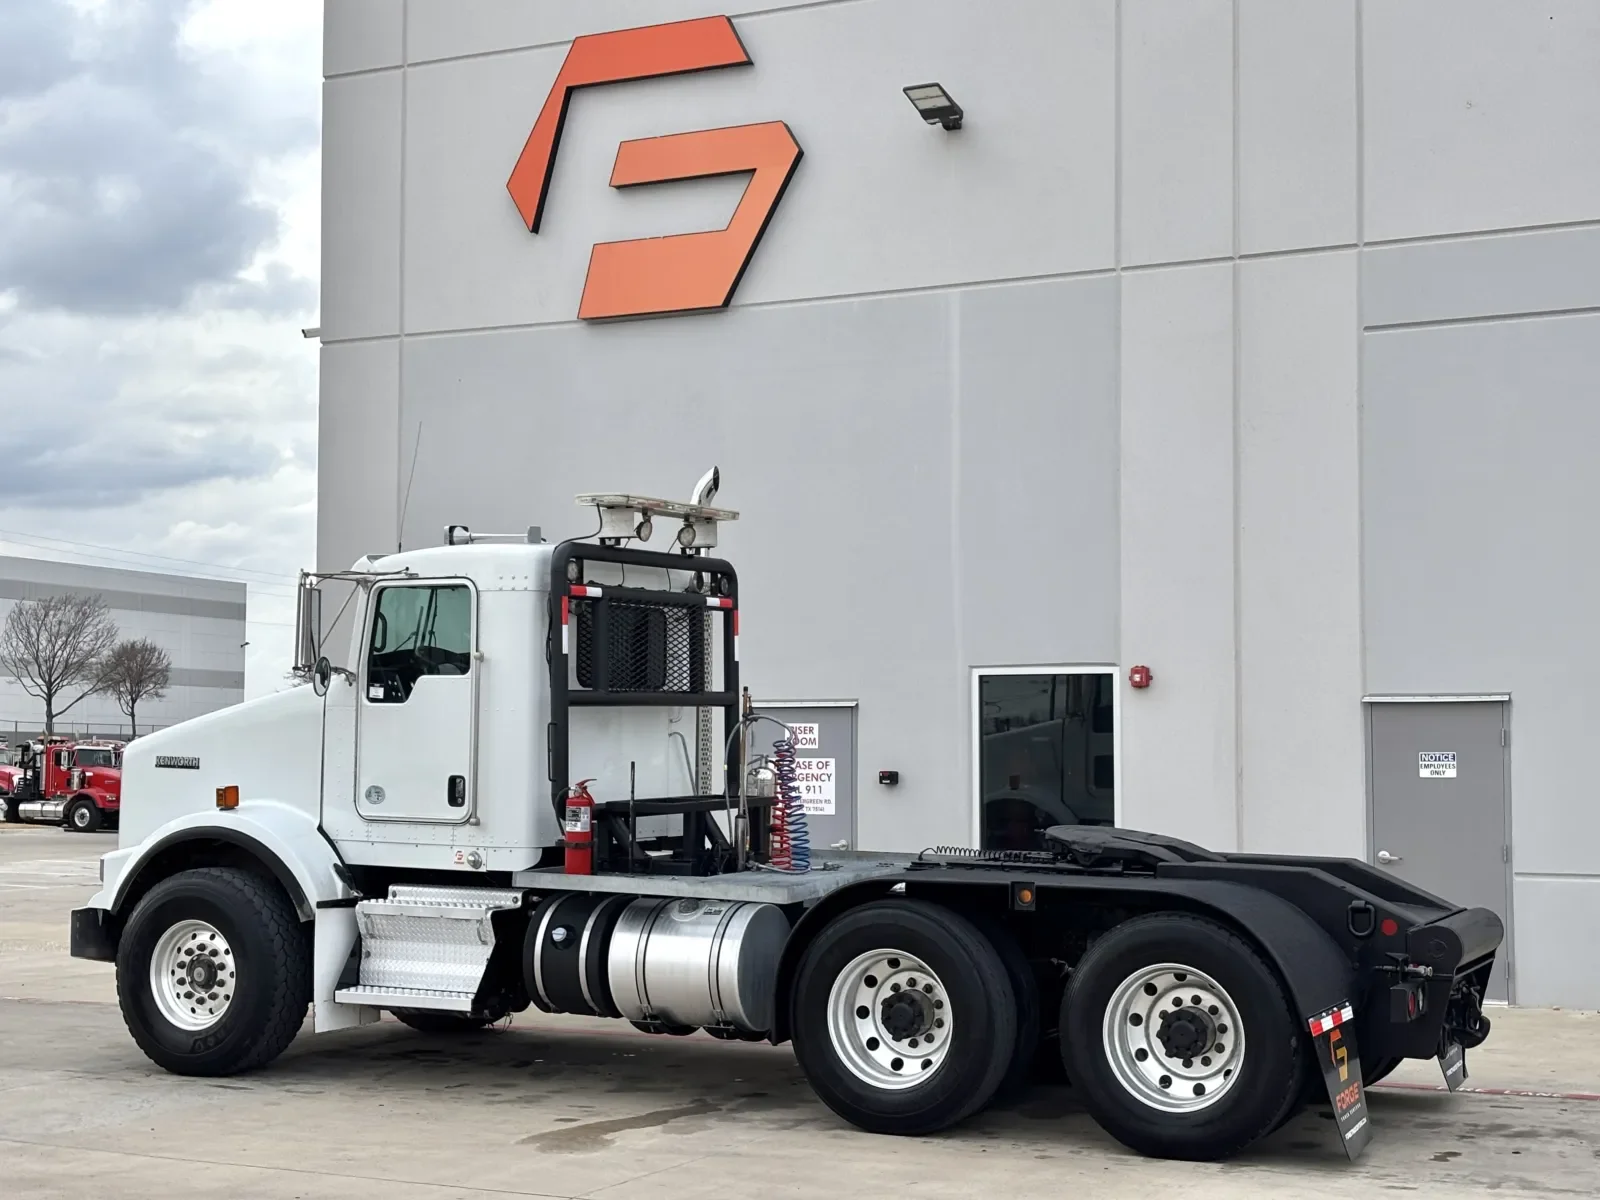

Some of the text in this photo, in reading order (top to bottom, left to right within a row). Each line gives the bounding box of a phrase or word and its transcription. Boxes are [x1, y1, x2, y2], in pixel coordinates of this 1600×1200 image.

[156, 756, 200, 767] KENWORTH
[1421, 754, 1455, 762] NOTICE
[795, 761, 830, 770] ASE OF
[805, 785, 822, 795] 911
[1336, 1081, 1360, 1113] FORGE
